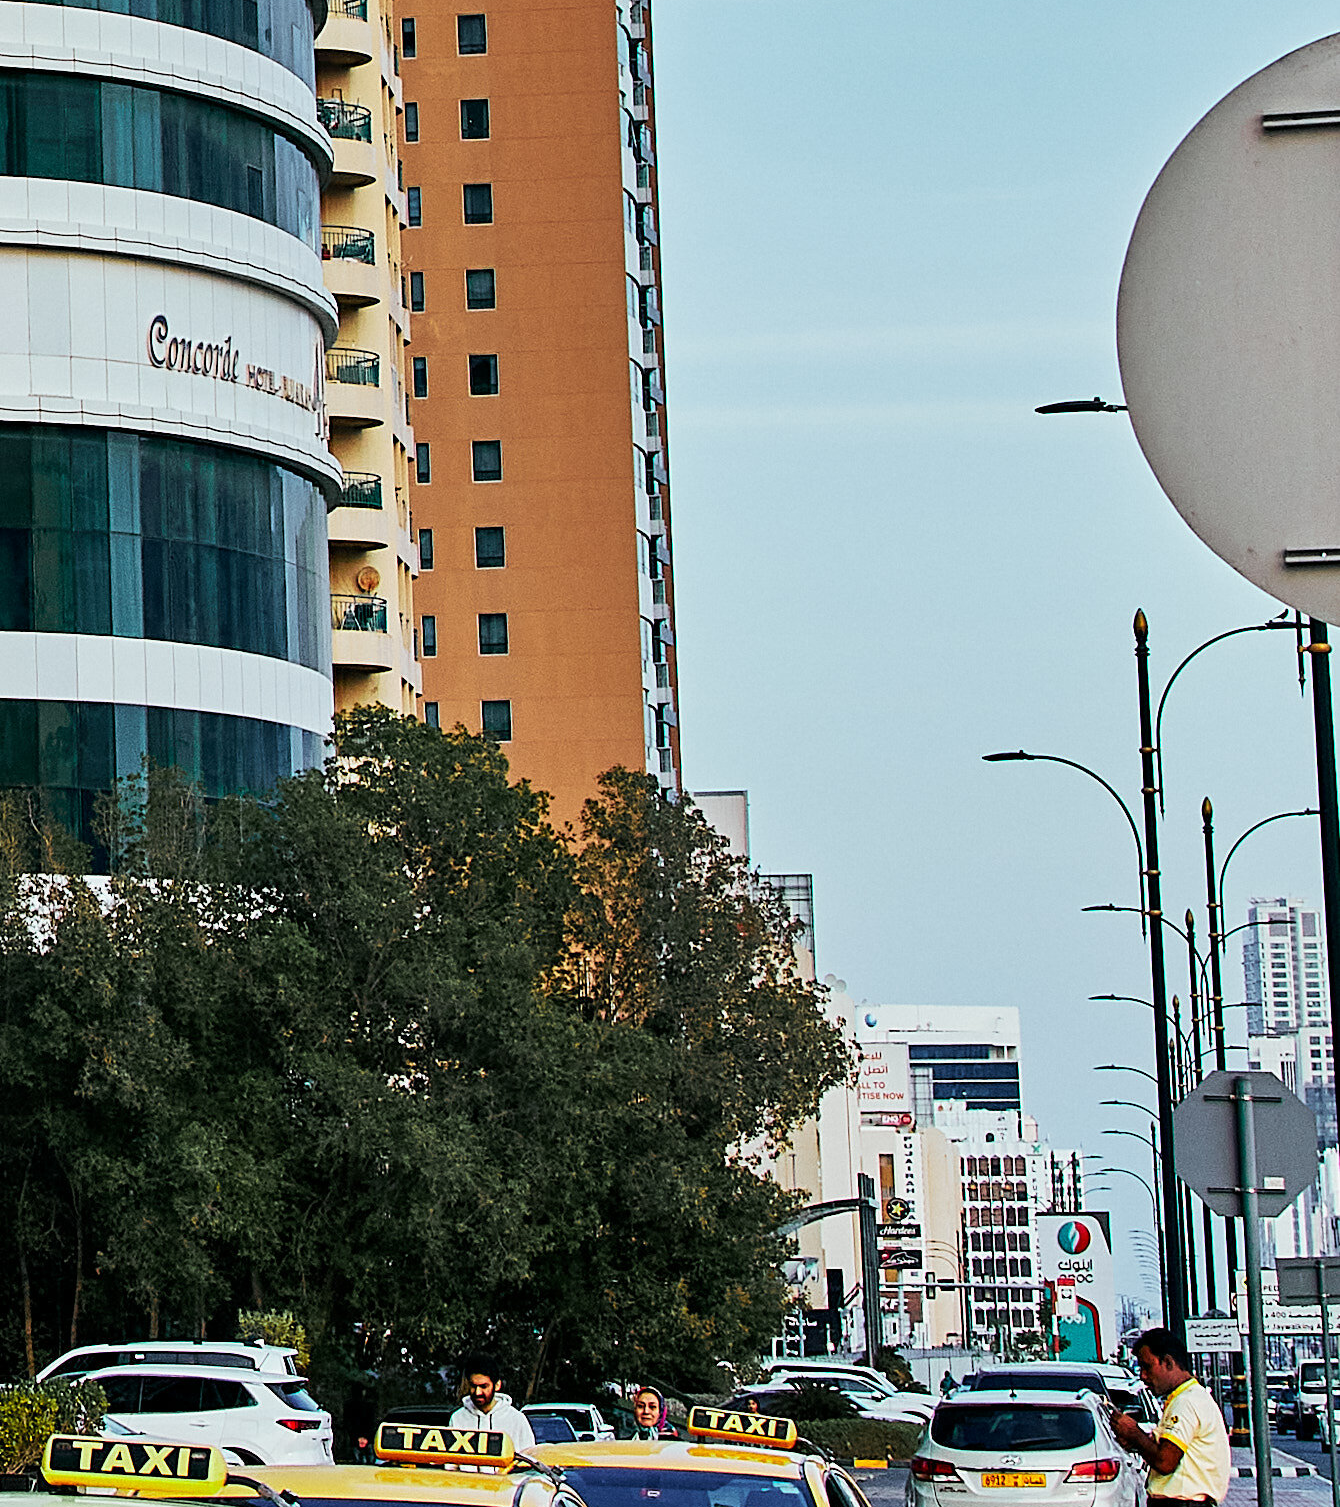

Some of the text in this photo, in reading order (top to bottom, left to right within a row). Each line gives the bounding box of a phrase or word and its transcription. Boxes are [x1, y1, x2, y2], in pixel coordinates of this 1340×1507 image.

[148, 314, 240, 383] Concorde
[873, 1081, 886, 1090] TO
[883, 1092, 905, 1100] NOW
[705, 1410, 777, 1437] TAXI
[396, 1427, 488, 1454] TAXI
[72, 1440, 191, 1477] TAXI
